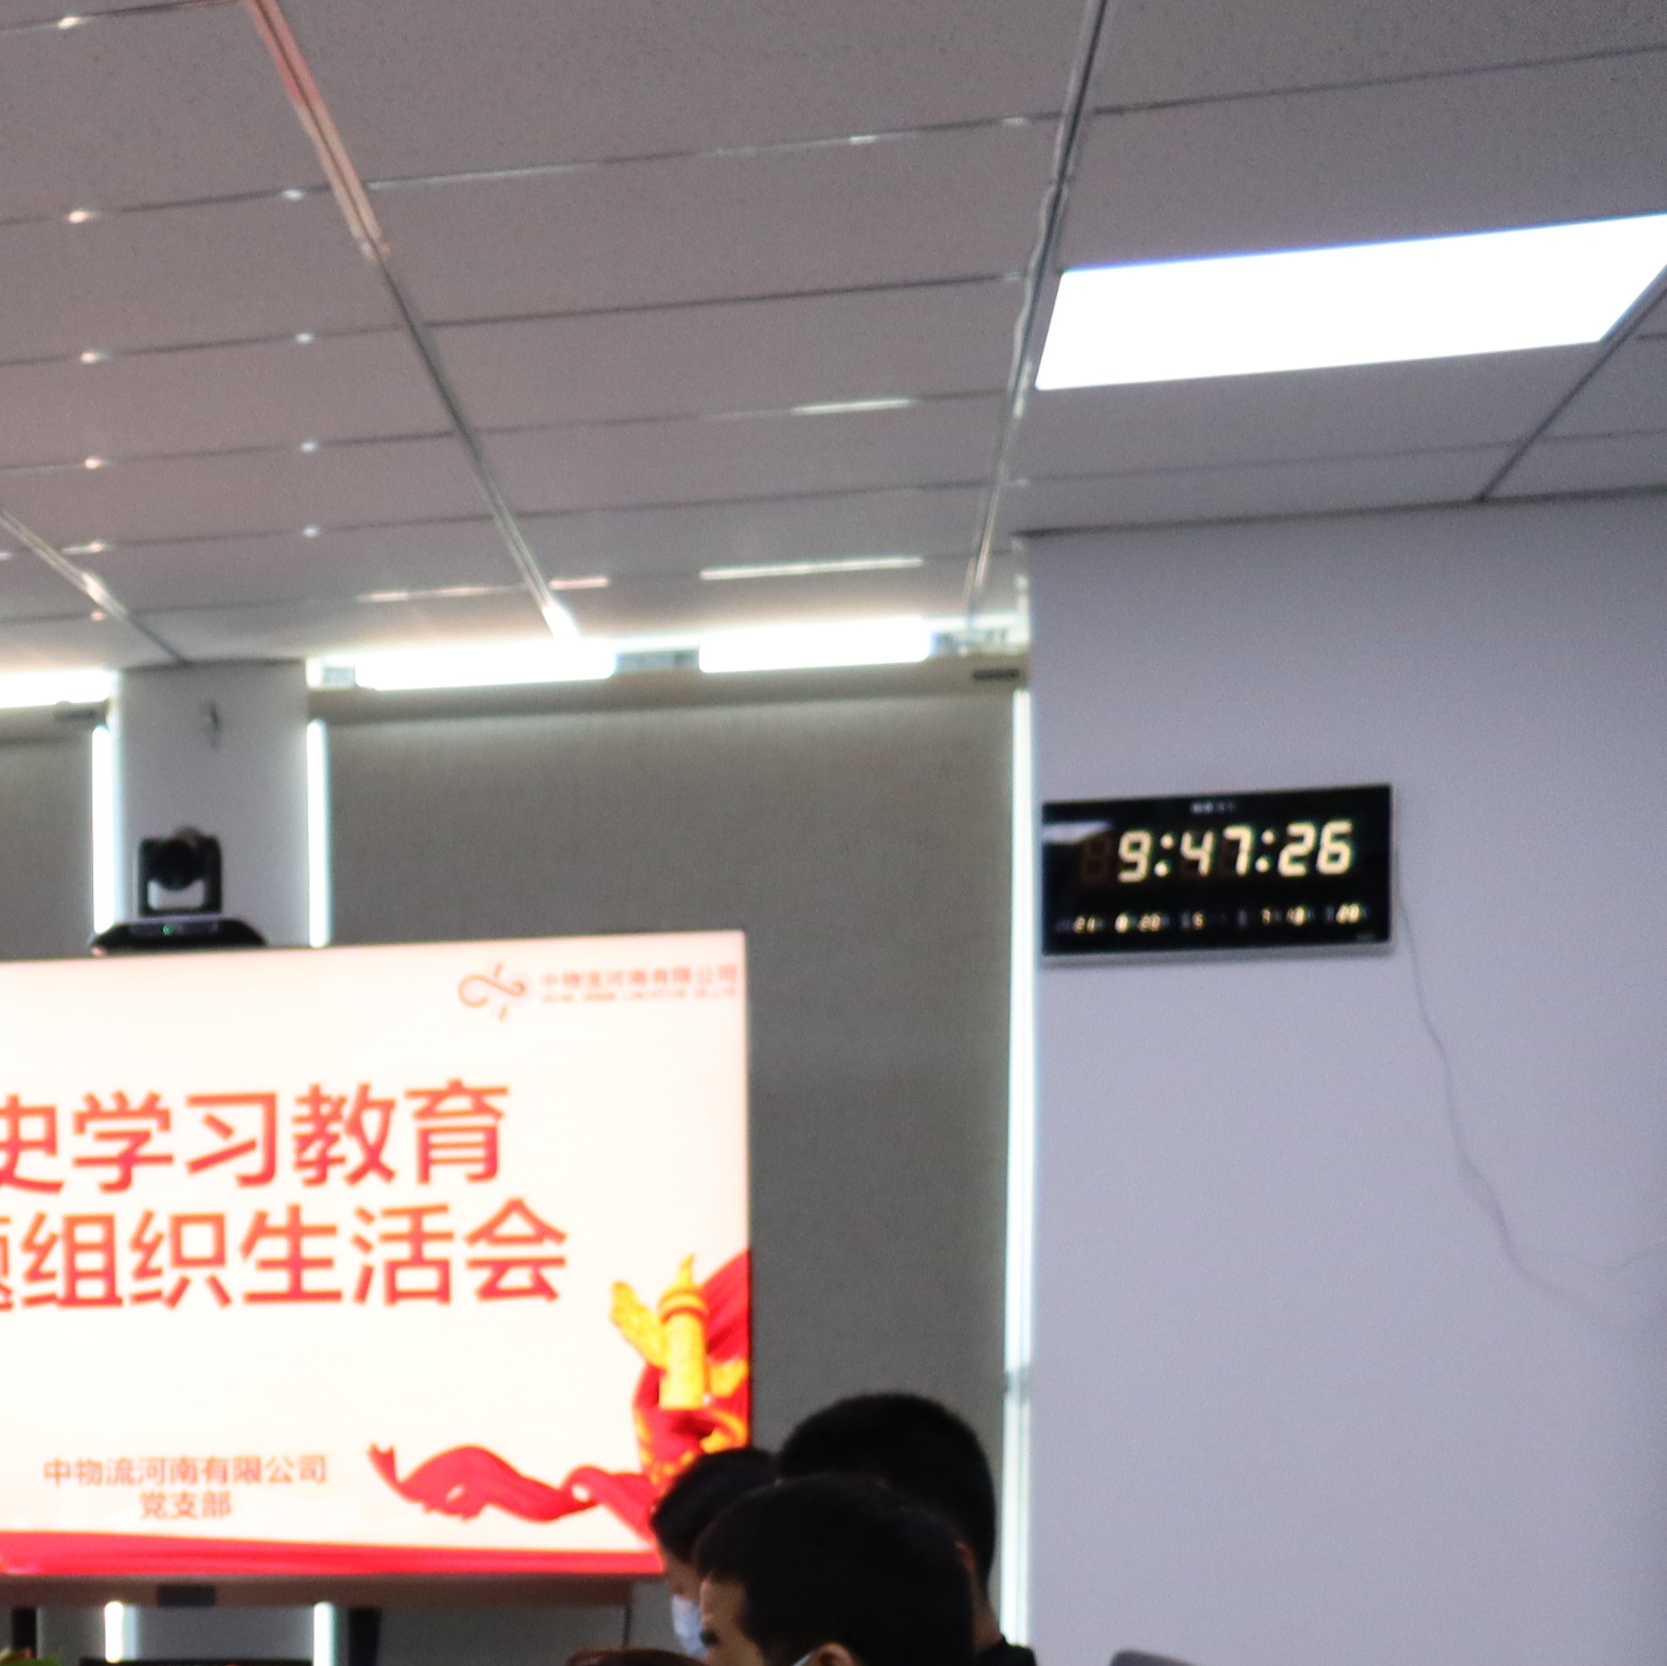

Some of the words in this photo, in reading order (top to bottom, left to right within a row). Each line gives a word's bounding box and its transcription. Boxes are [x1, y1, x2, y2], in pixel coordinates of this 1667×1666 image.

[1118, 820, 1354, 883] 9:47:26
[43, 1454, 327, 1487] 中物流河南有限公司
[139, 1491, 233, 1520] 党支部
